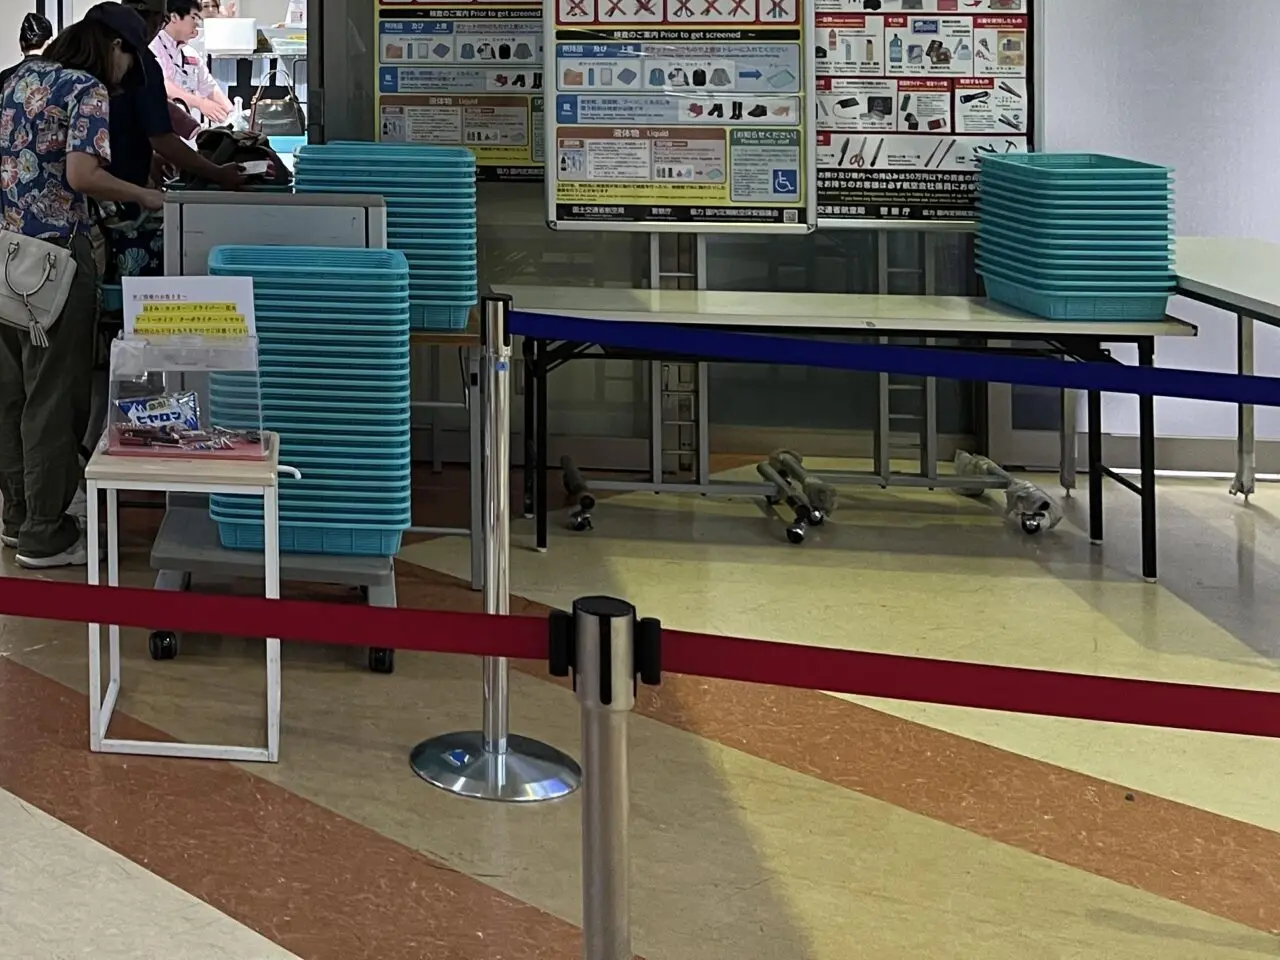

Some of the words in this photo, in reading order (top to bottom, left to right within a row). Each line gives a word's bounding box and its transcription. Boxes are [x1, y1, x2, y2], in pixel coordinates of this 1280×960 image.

[691, 32, 703, 40] get
[136, 411, 181, 425] ヒヤロン
